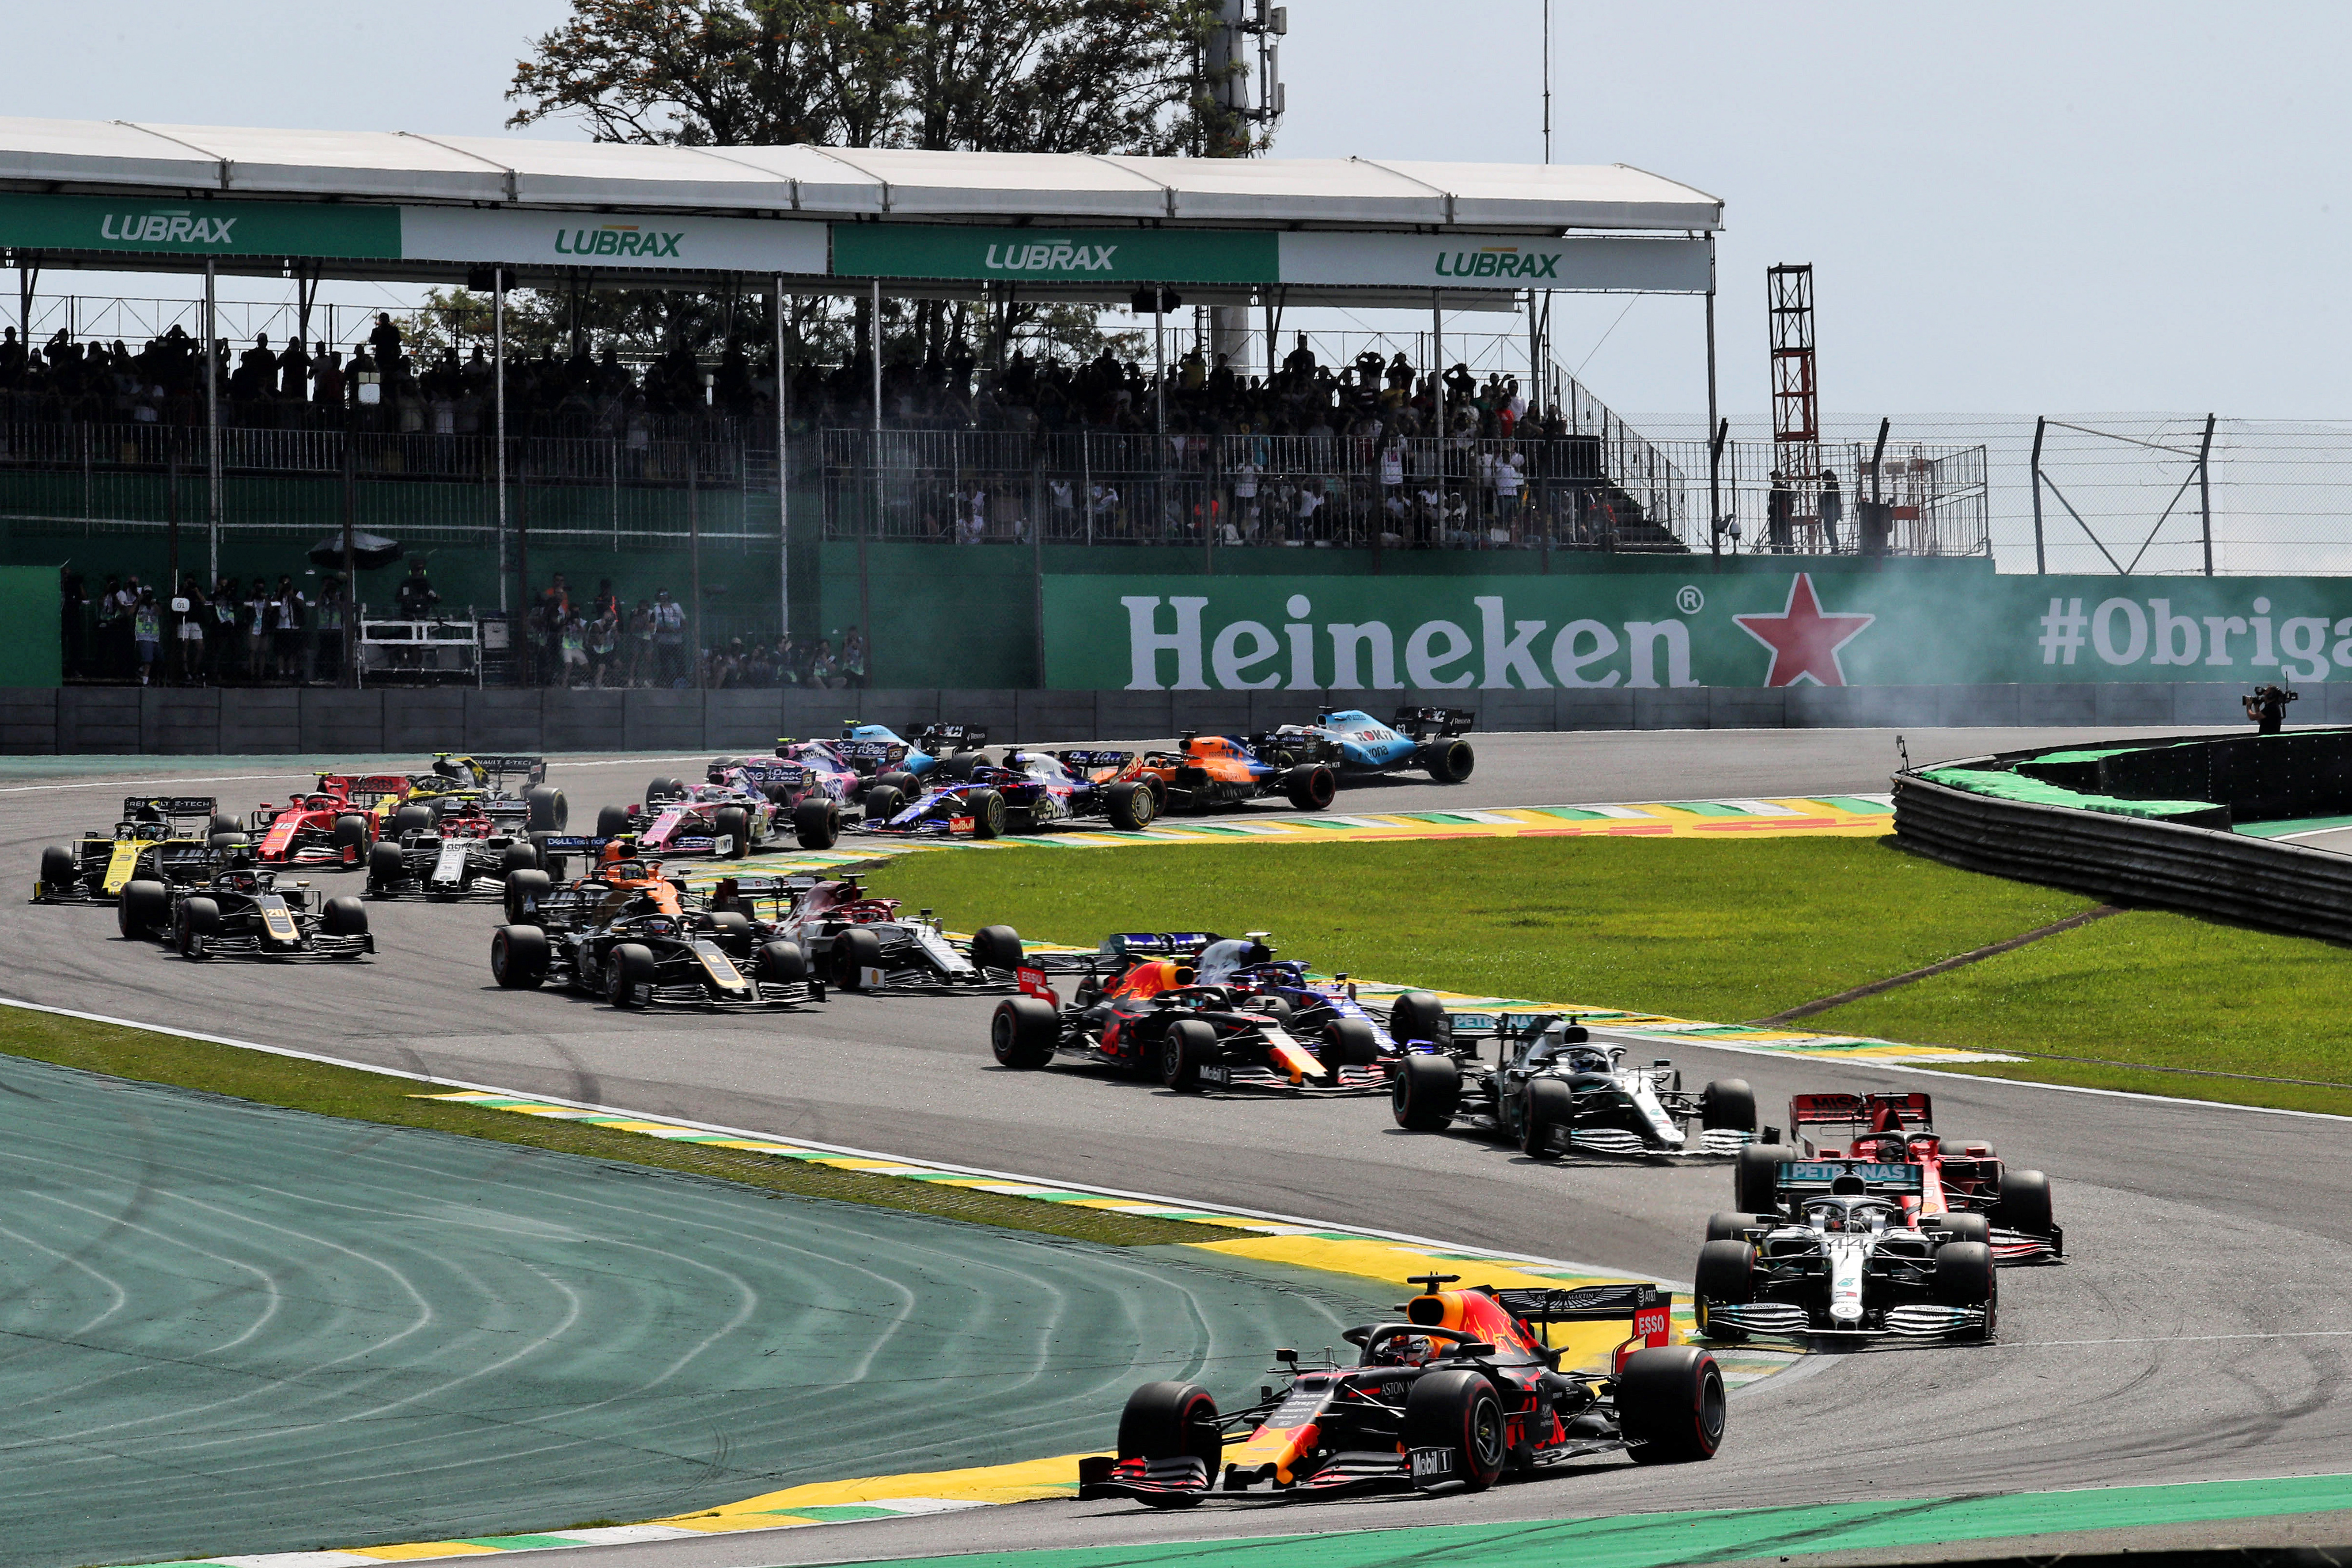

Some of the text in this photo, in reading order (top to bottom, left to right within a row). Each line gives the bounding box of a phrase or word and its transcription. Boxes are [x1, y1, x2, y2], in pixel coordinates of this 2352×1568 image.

[101, 214, 237, 243] LUBRAX
[555, 229, 684, 257] LUBRAX
[985, 244, 1118, 270] LUBRAX
[1435, 252, 1562, 278] LUBRAX
[1120, 594, 1700, 691] Heineken
[265, 909, 286, 917] 20
[1021, 971, 1043, 984] ESSO
[1645, 1291, 1656, 1303] AT&T
[1638, 1314, 1664, 1335] ESSO
[1381, 1382, 1405, 1396] ASTON
[1413, 1451, 1438, 1477] Mobil
